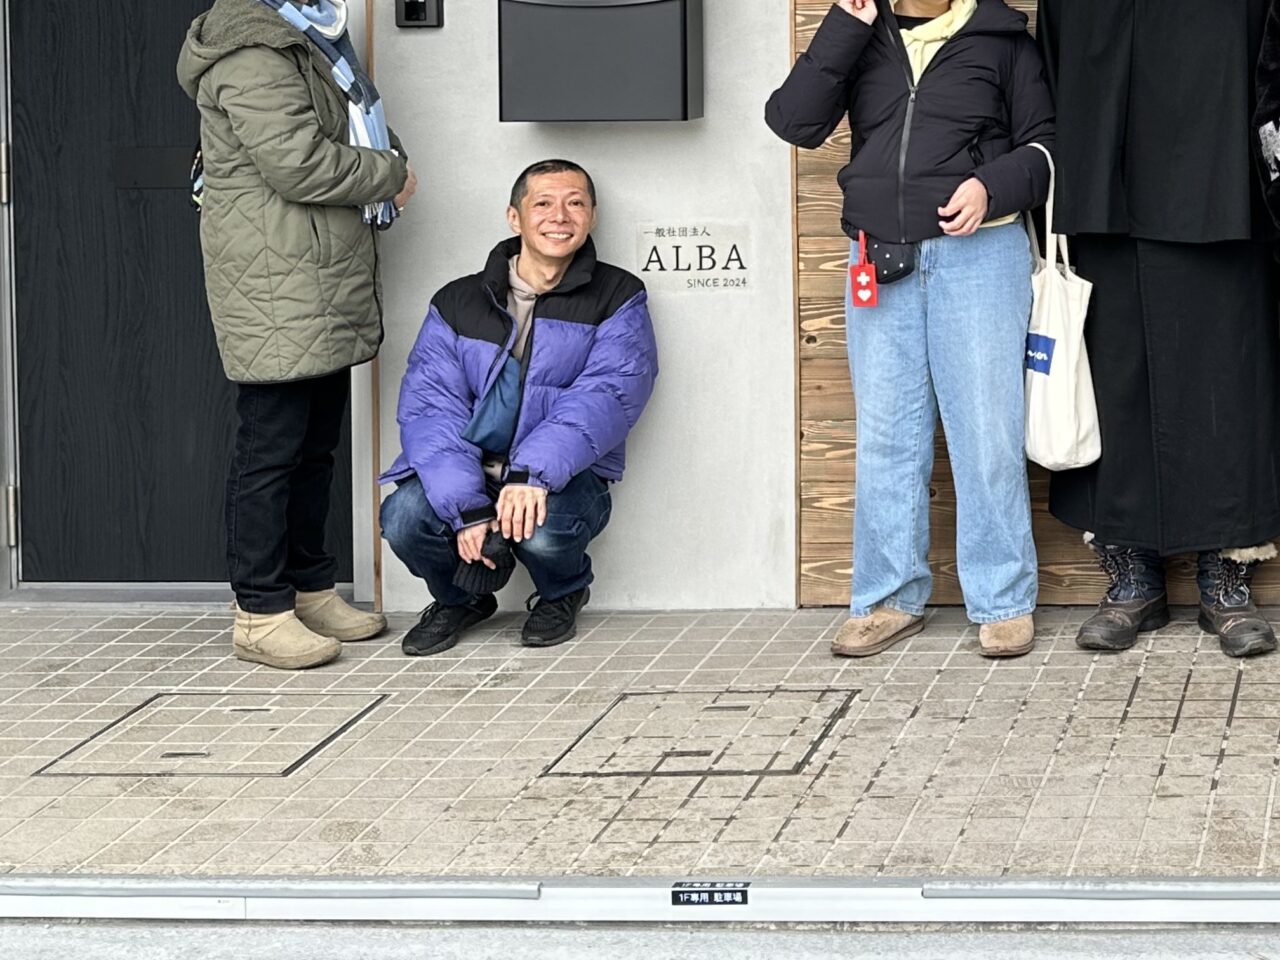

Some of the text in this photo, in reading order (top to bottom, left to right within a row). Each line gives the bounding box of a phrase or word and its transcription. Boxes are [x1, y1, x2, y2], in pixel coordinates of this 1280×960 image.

[641, 243, 747, 272] ALBA
[687, 277, 747, 288] SINCE 2024
